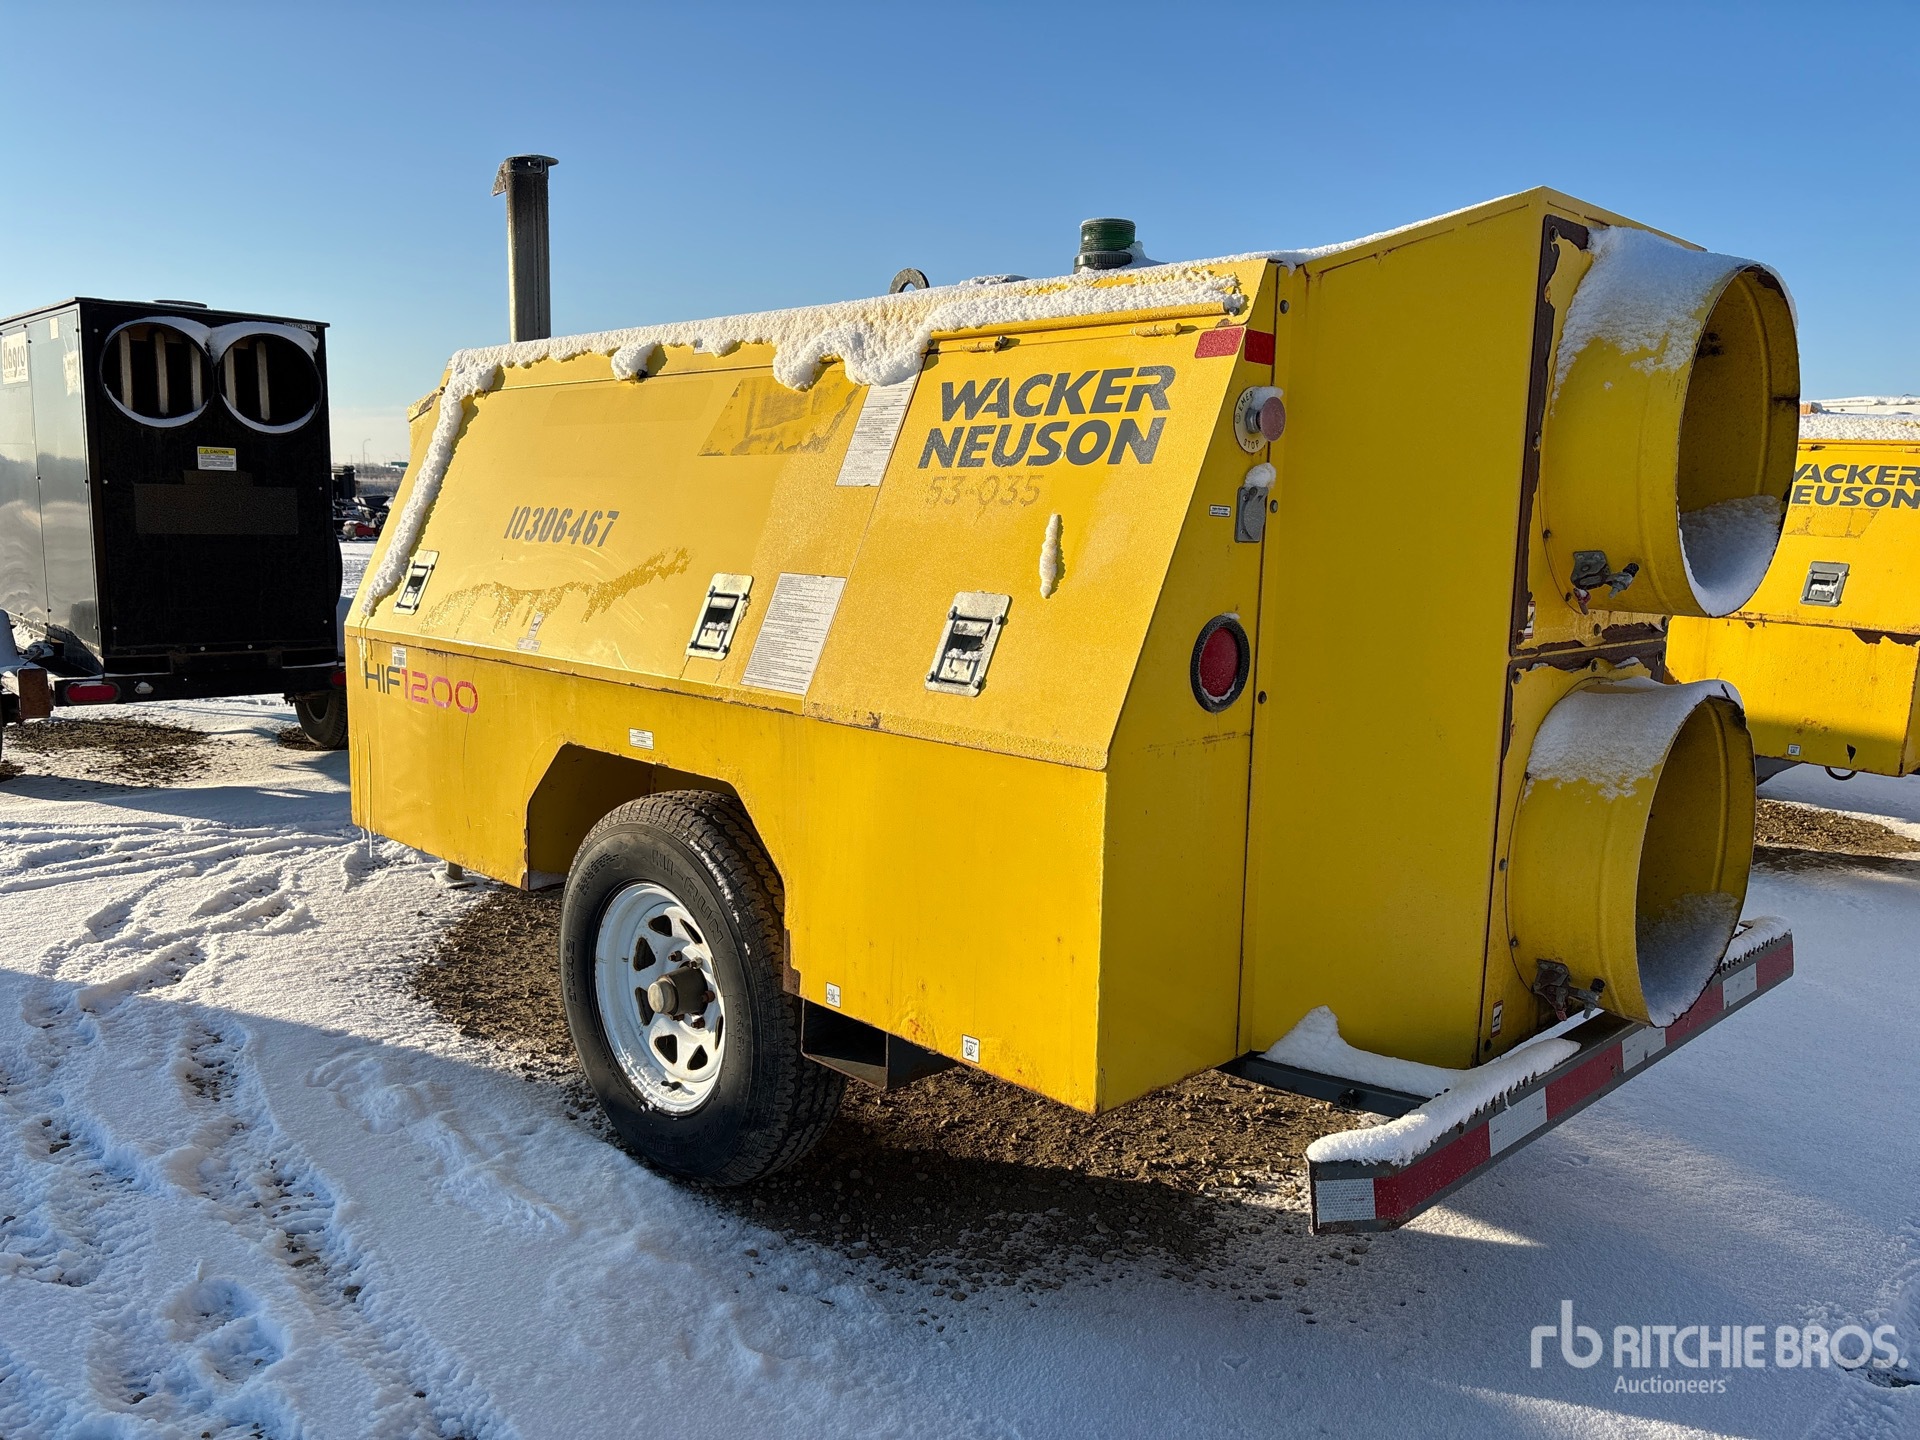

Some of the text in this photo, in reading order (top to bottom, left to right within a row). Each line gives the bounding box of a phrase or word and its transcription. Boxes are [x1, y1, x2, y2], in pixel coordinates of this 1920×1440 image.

[941, 366, 1177, 421] WACKER
[918, 416, 1167, 468] NEUSON
[1243, 439, 1259, 449] STOP
[926, 475, 1045, 507] 53-035
[1791, 485, 1920, 509] EUSON
[503, 506, 620, 548] 10306467
[364, 661, 479, 714] HIF1200
